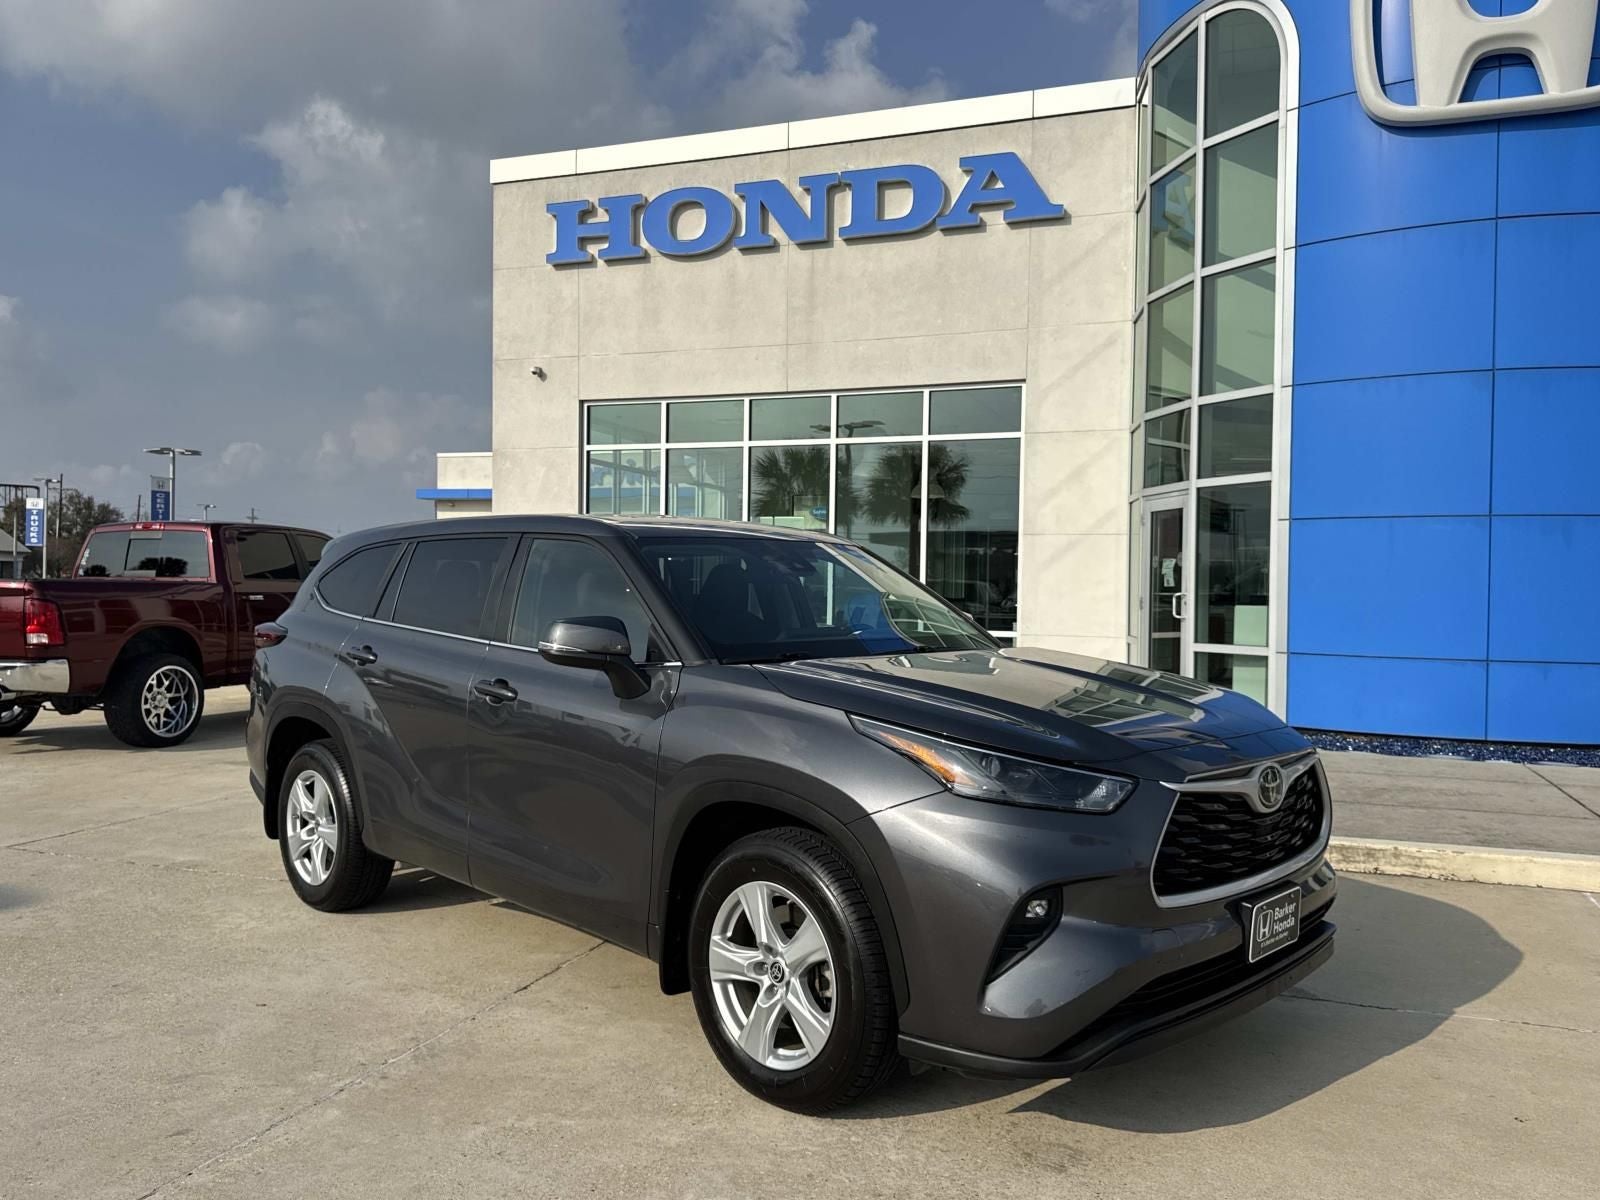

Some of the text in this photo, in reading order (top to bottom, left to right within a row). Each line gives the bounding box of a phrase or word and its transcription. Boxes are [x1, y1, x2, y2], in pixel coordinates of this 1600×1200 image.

[545, 151, 1065, 265] HONDA
[30, 510, 39, 543] TRUCKS
[1274, 902, 1296, 920] Barker
[1273, 915, 1295, 934] Honda
